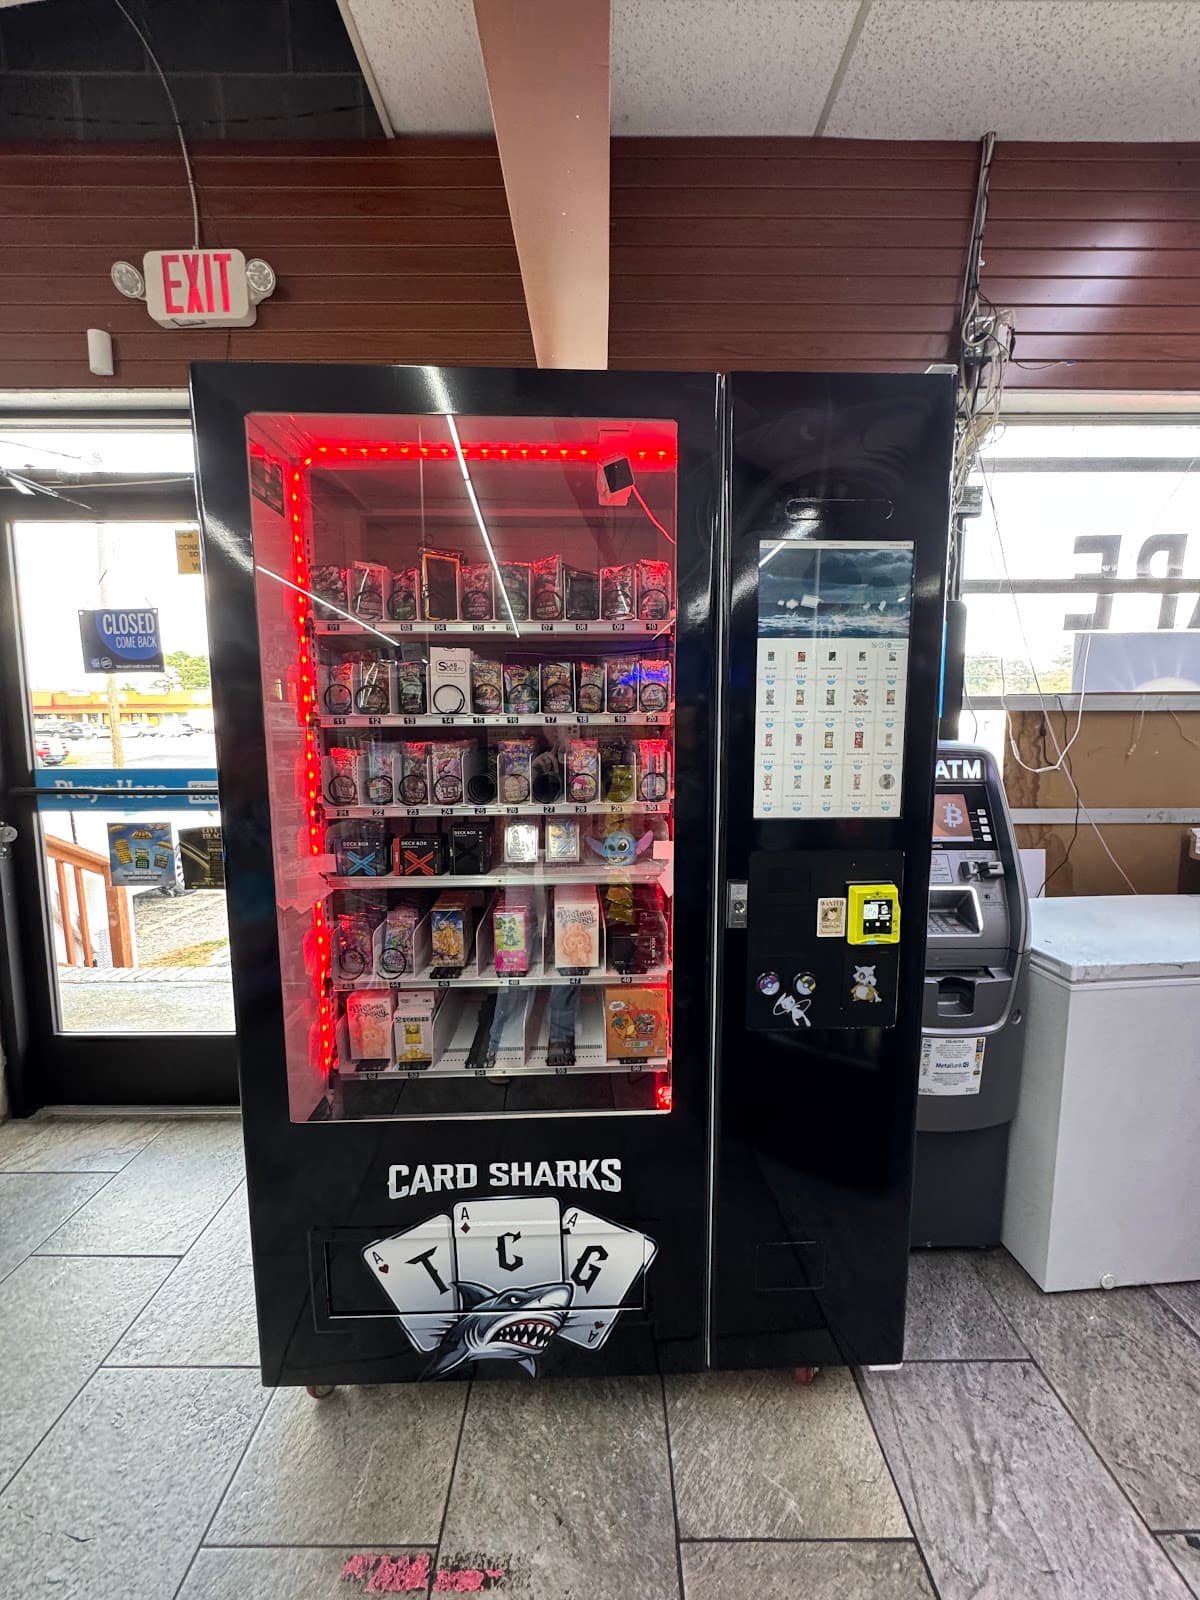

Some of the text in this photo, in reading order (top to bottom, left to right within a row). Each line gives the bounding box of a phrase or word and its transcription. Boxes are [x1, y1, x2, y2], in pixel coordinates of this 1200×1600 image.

[161, 254, 232, 314] EXIT
[102, 613, 155, 635] CLOSED
[116, 635, 158, 649] COME BACK
[935, 760, 981, 779] ATM
[387, 1158, 622, 1199] CARD SHARKS
[461, 1207, 470, 1220] A
[567, 1212, 578, 1227] A
[372, 1251, 384, 1264] A
